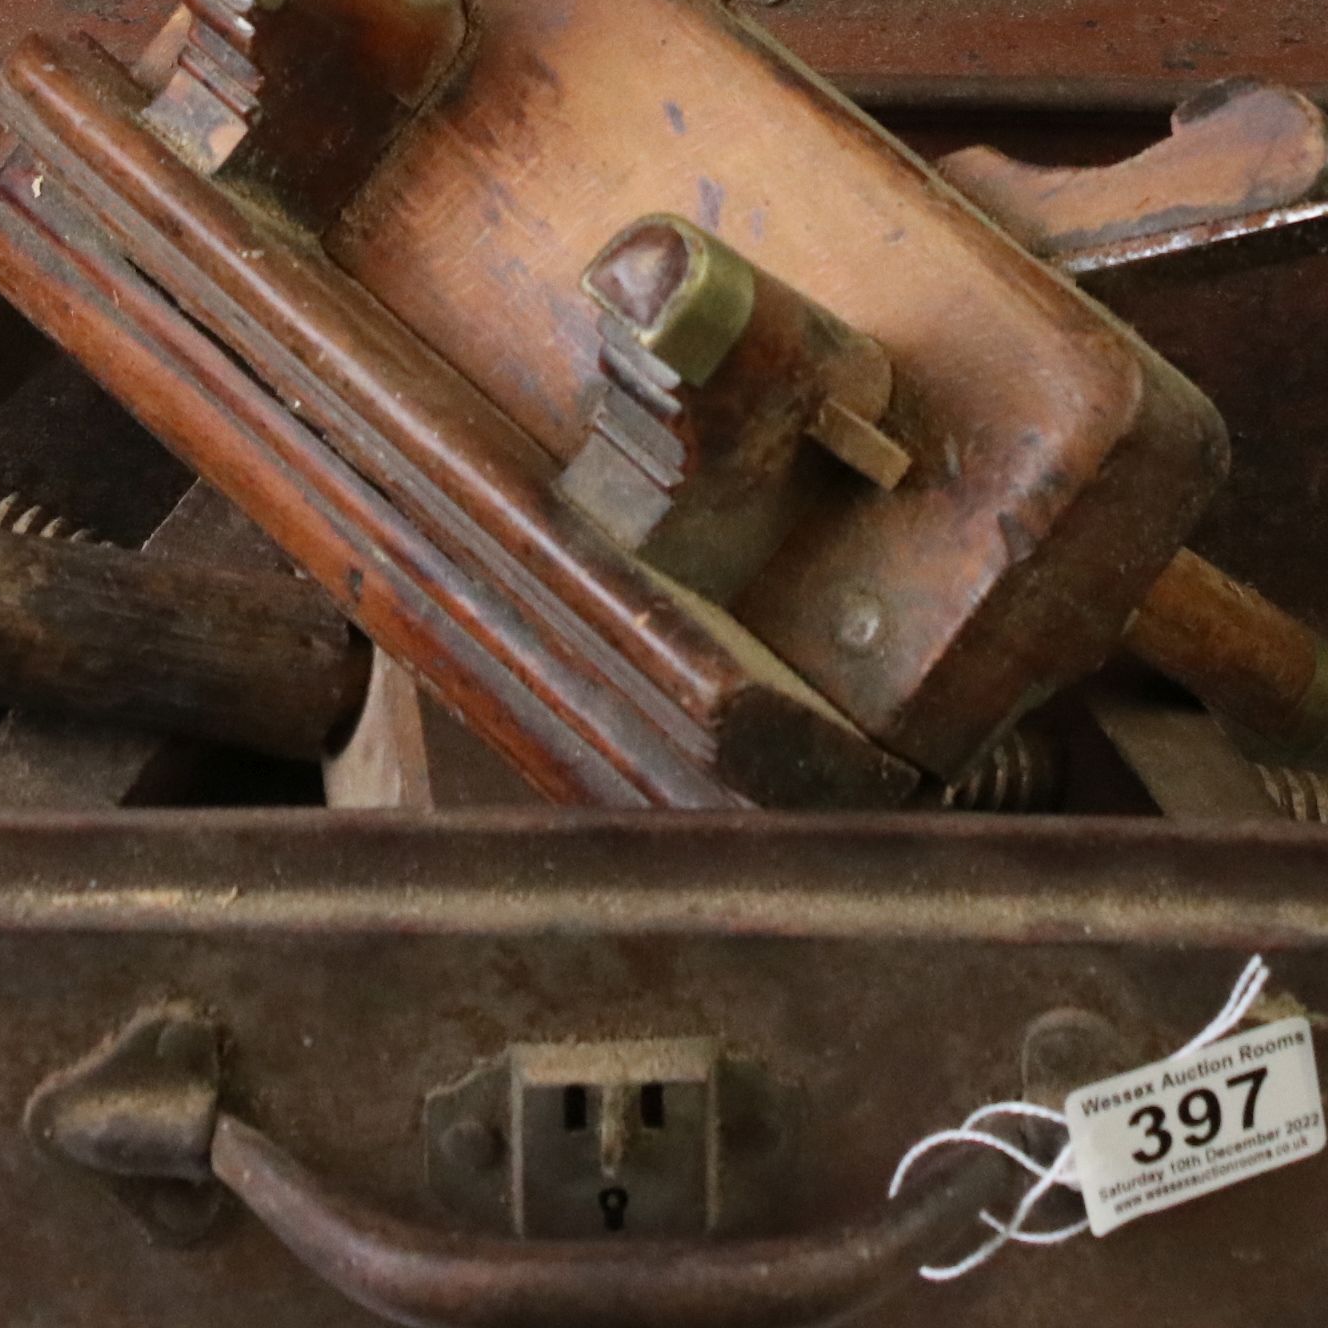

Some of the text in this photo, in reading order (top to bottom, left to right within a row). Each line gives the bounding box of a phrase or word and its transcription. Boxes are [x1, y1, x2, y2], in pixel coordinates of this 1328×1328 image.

[1080, 1030, 1305, 1117] Wessex Auction Rooms
[1128, 1066, 1268, 1164] 397
[1099, 1112, 1320, 1202] Saturday 10th December 2022
